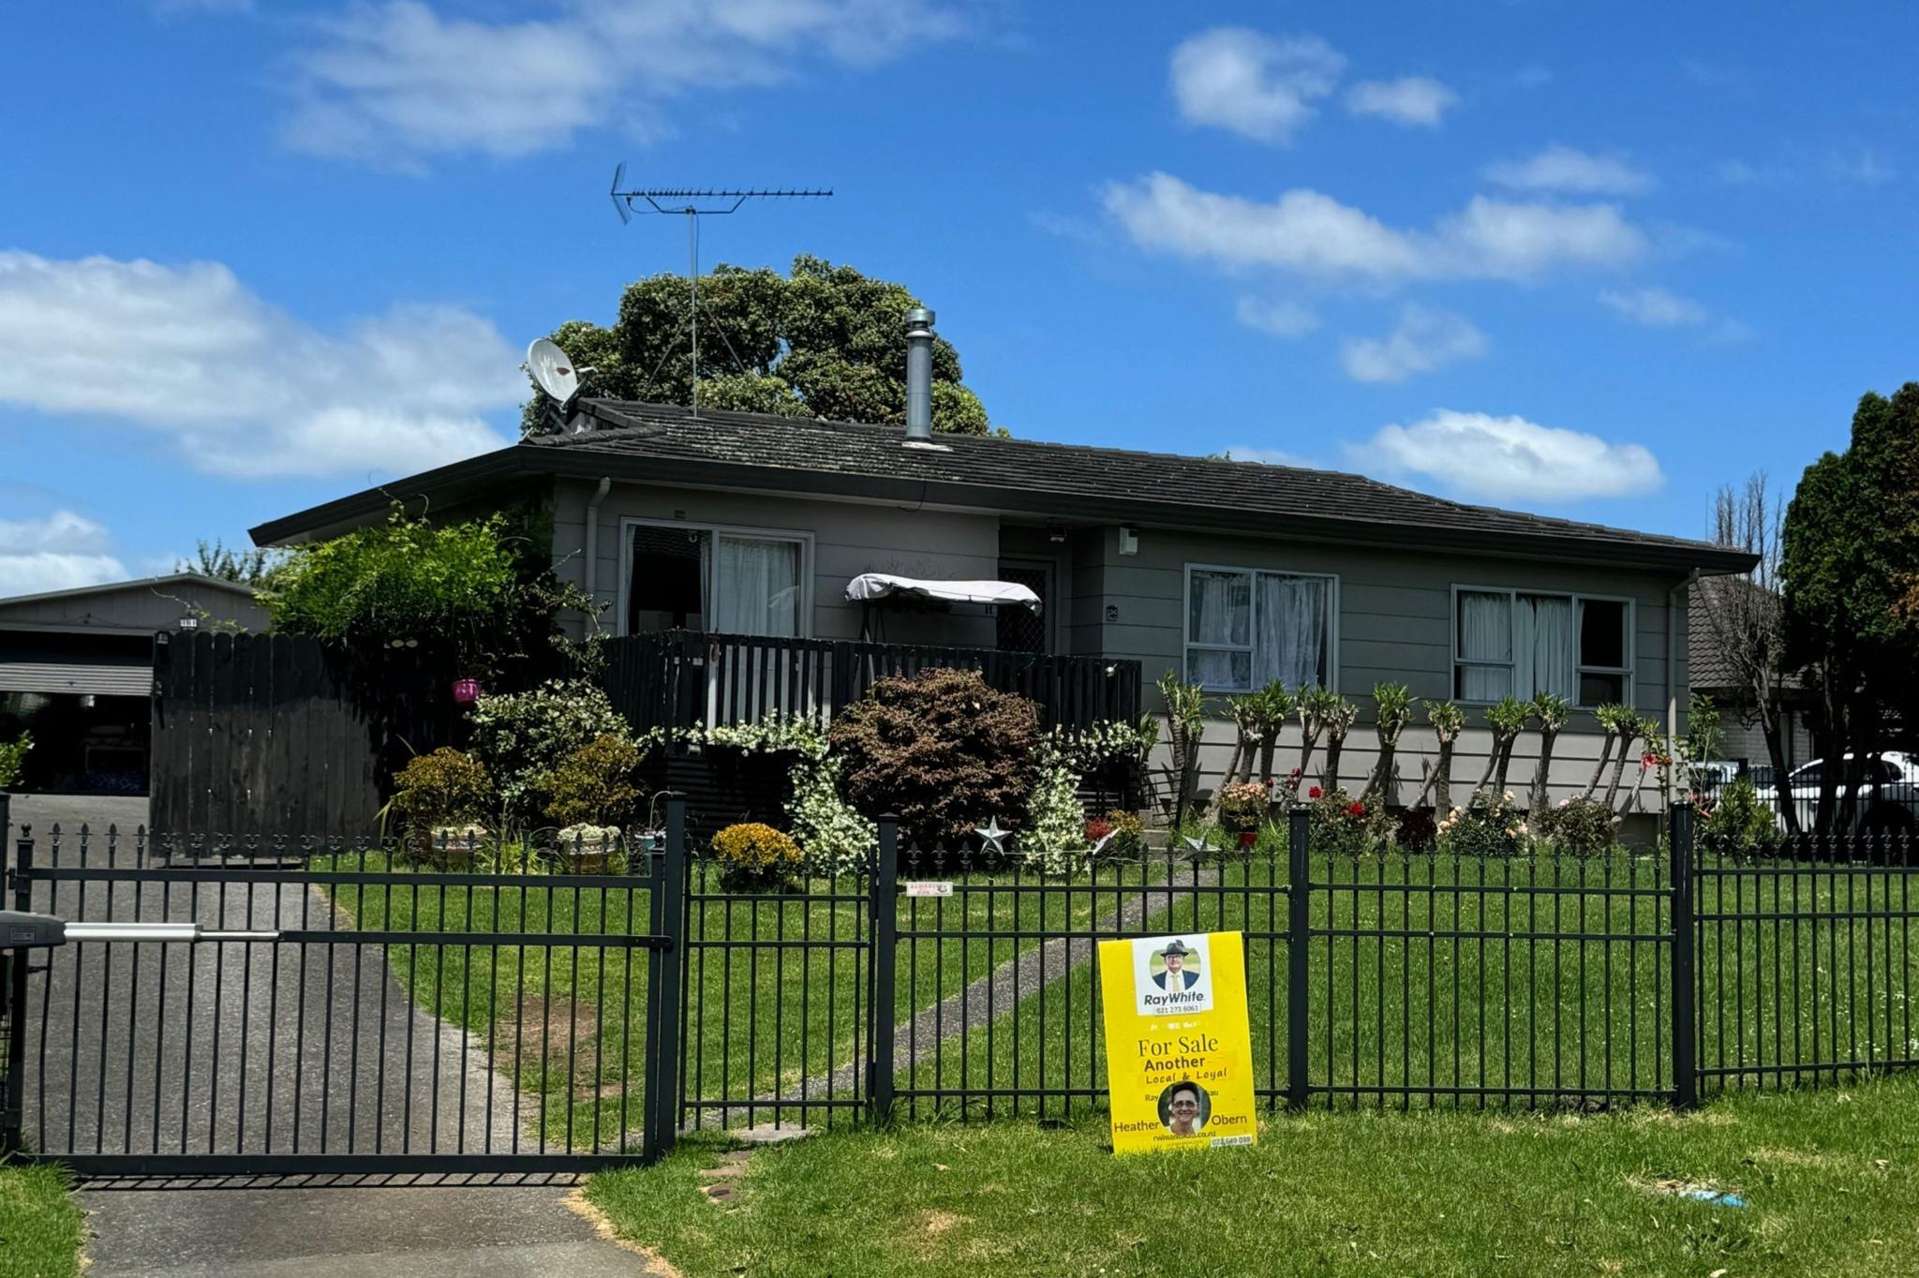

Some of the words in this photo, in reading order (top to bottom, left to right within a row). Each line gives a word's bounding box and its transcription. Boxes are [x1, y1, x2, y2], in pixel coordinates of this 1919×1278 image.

[1137, 1039, 1172, 1057] For
[1178, 1033, 1218, 1054] Sale
[1144, 1056, 1205, 1072] Another
[1146, 1073, 1176, 1084] Local
[1196, 1067, 1227, 1080] Loyal
[1114, 1120, 1160, 1133] Heather
[1211, 1115, 1248, 1126] Obern
